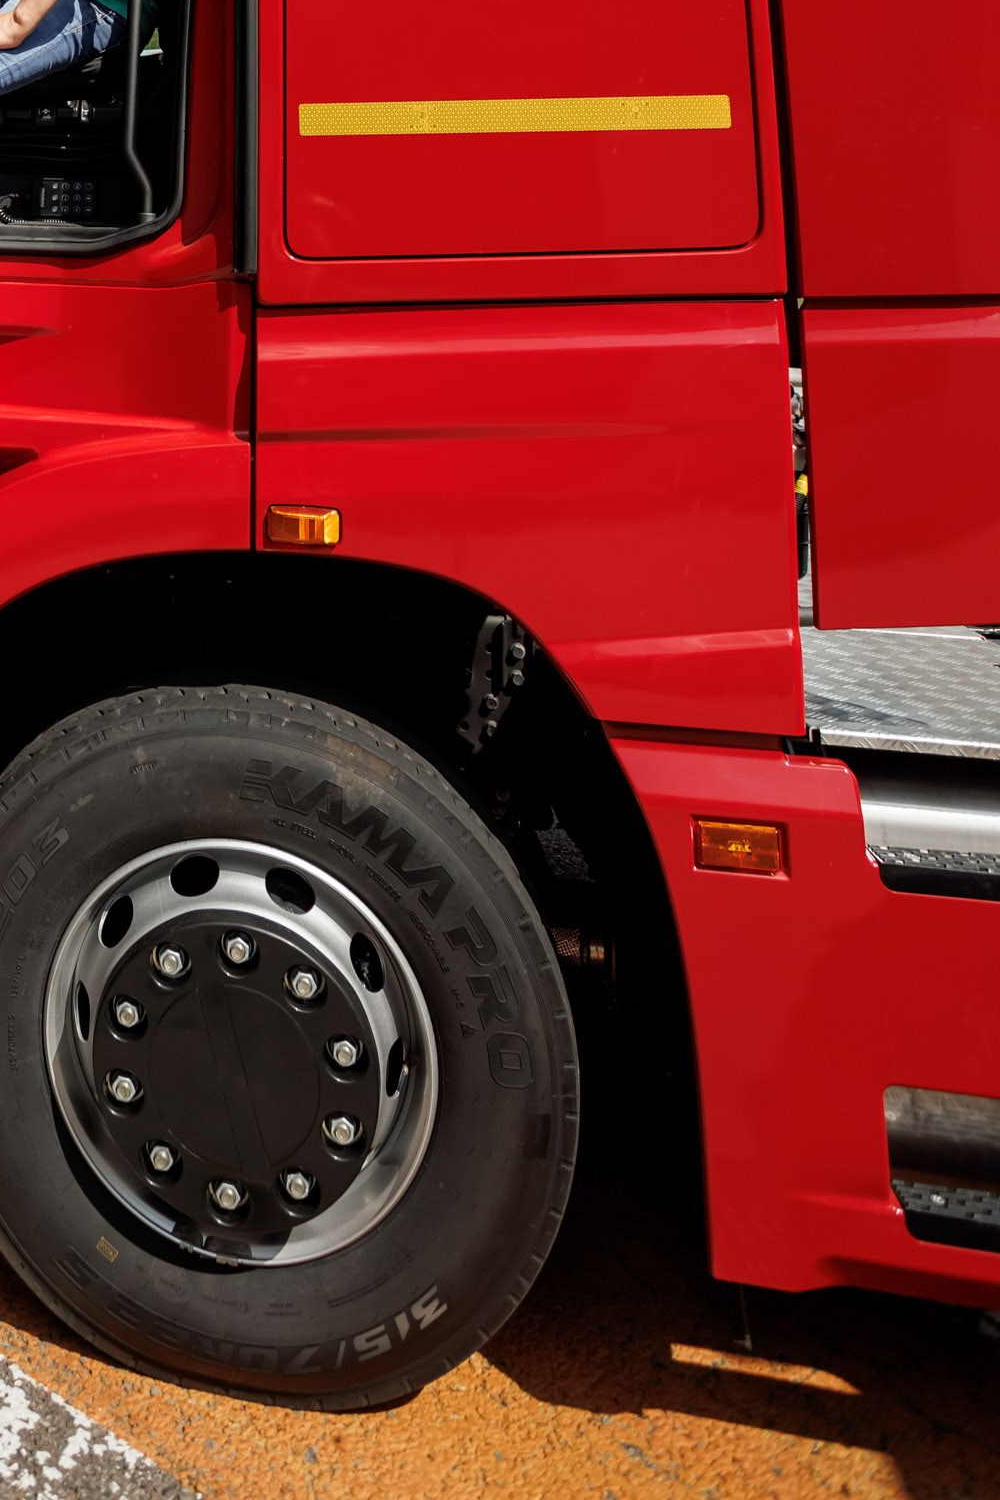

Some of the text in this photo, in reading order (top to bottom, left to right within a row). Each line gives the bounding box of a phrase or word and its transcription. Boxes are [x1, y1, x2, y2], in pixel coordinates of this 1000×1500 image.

[239, 757, 533, 1089] KAMA PRO
[290, 821, 318, 839] STEEL
[366, 863, 402, 902] TUBELESS
[407, 910, 450, 974] REGROOVABLE
